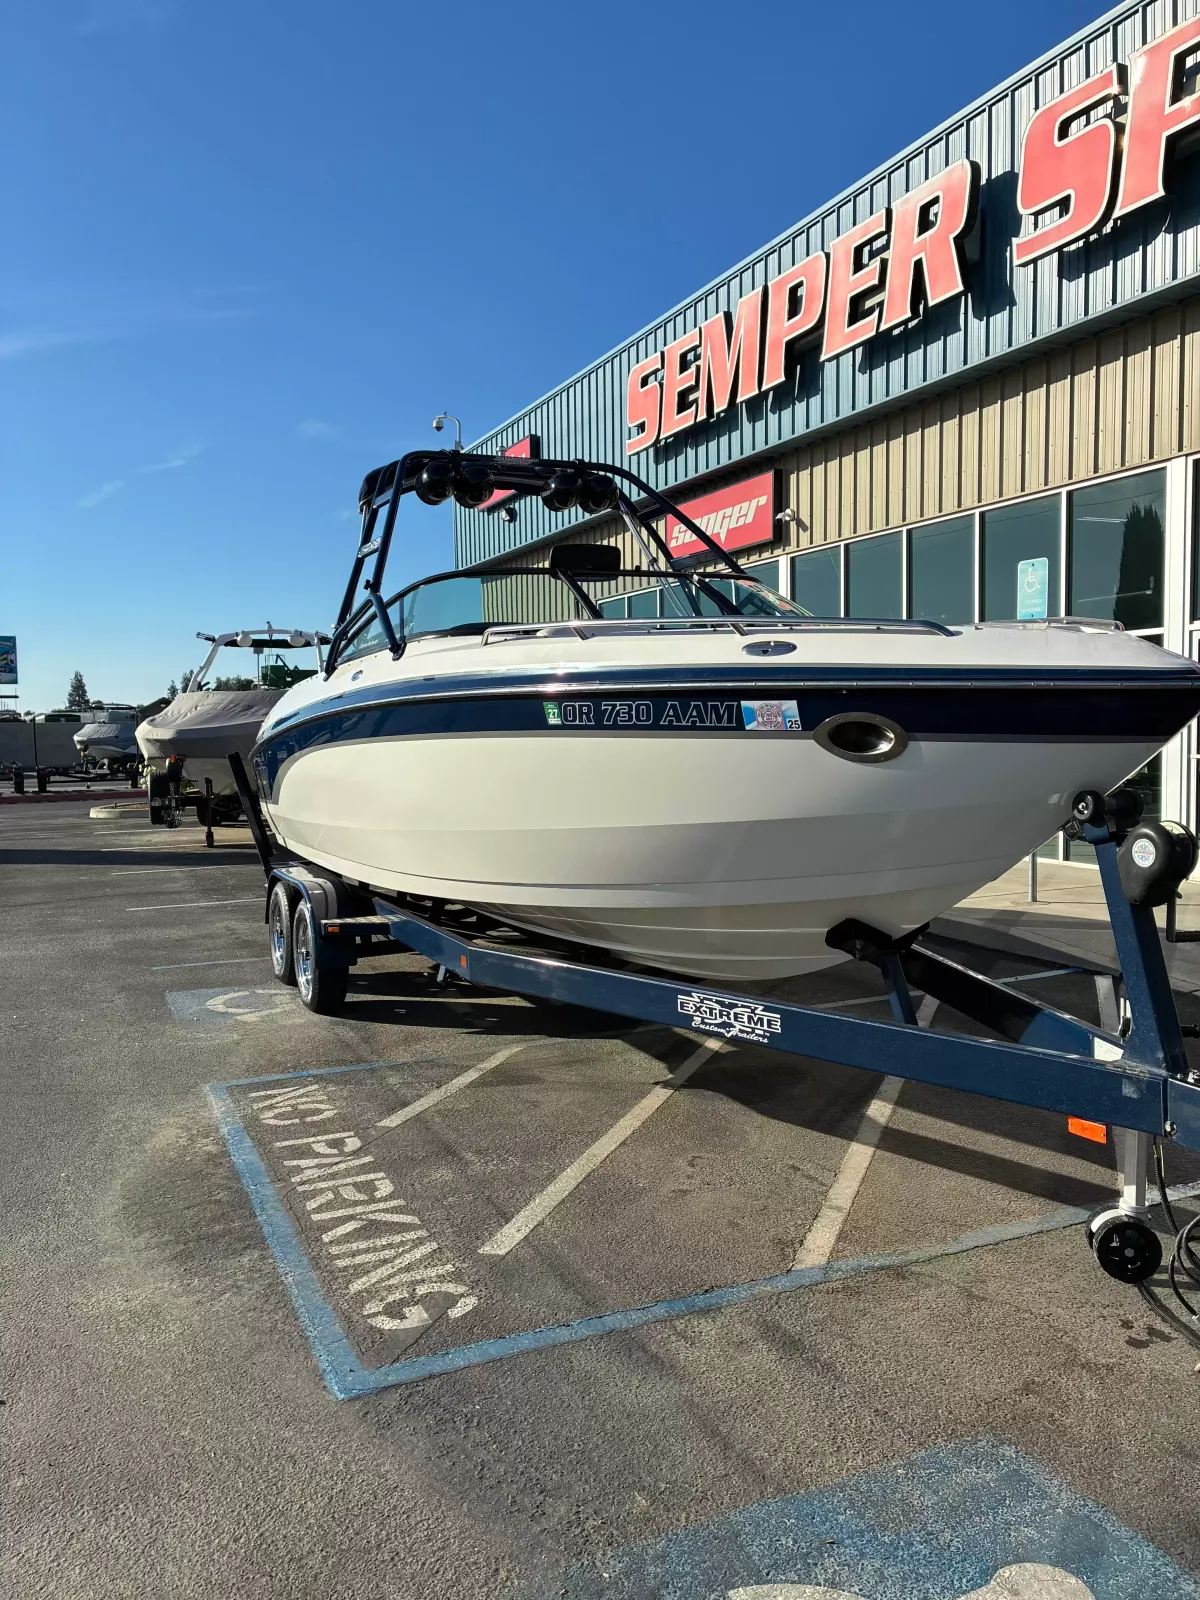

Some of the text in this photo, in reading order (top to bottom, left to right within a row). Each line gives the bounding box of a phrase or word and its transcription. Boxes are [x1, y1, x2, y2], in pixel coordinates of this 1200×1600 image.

[626, 158, 975, 456] SEMPER
[547, 709, 558, 719] 27
[561, 702, 595, 724] OR
[601, 702, 654, 725] 730
[660, 702, 738, 726] AAM
[787, 719, 801, 730] 25
[677, 998, 781, 1033] EXTREME
[691, 1019, 769, 1043] Custom Trailers
[249, 1084, 479, 1330] NO PARKING
